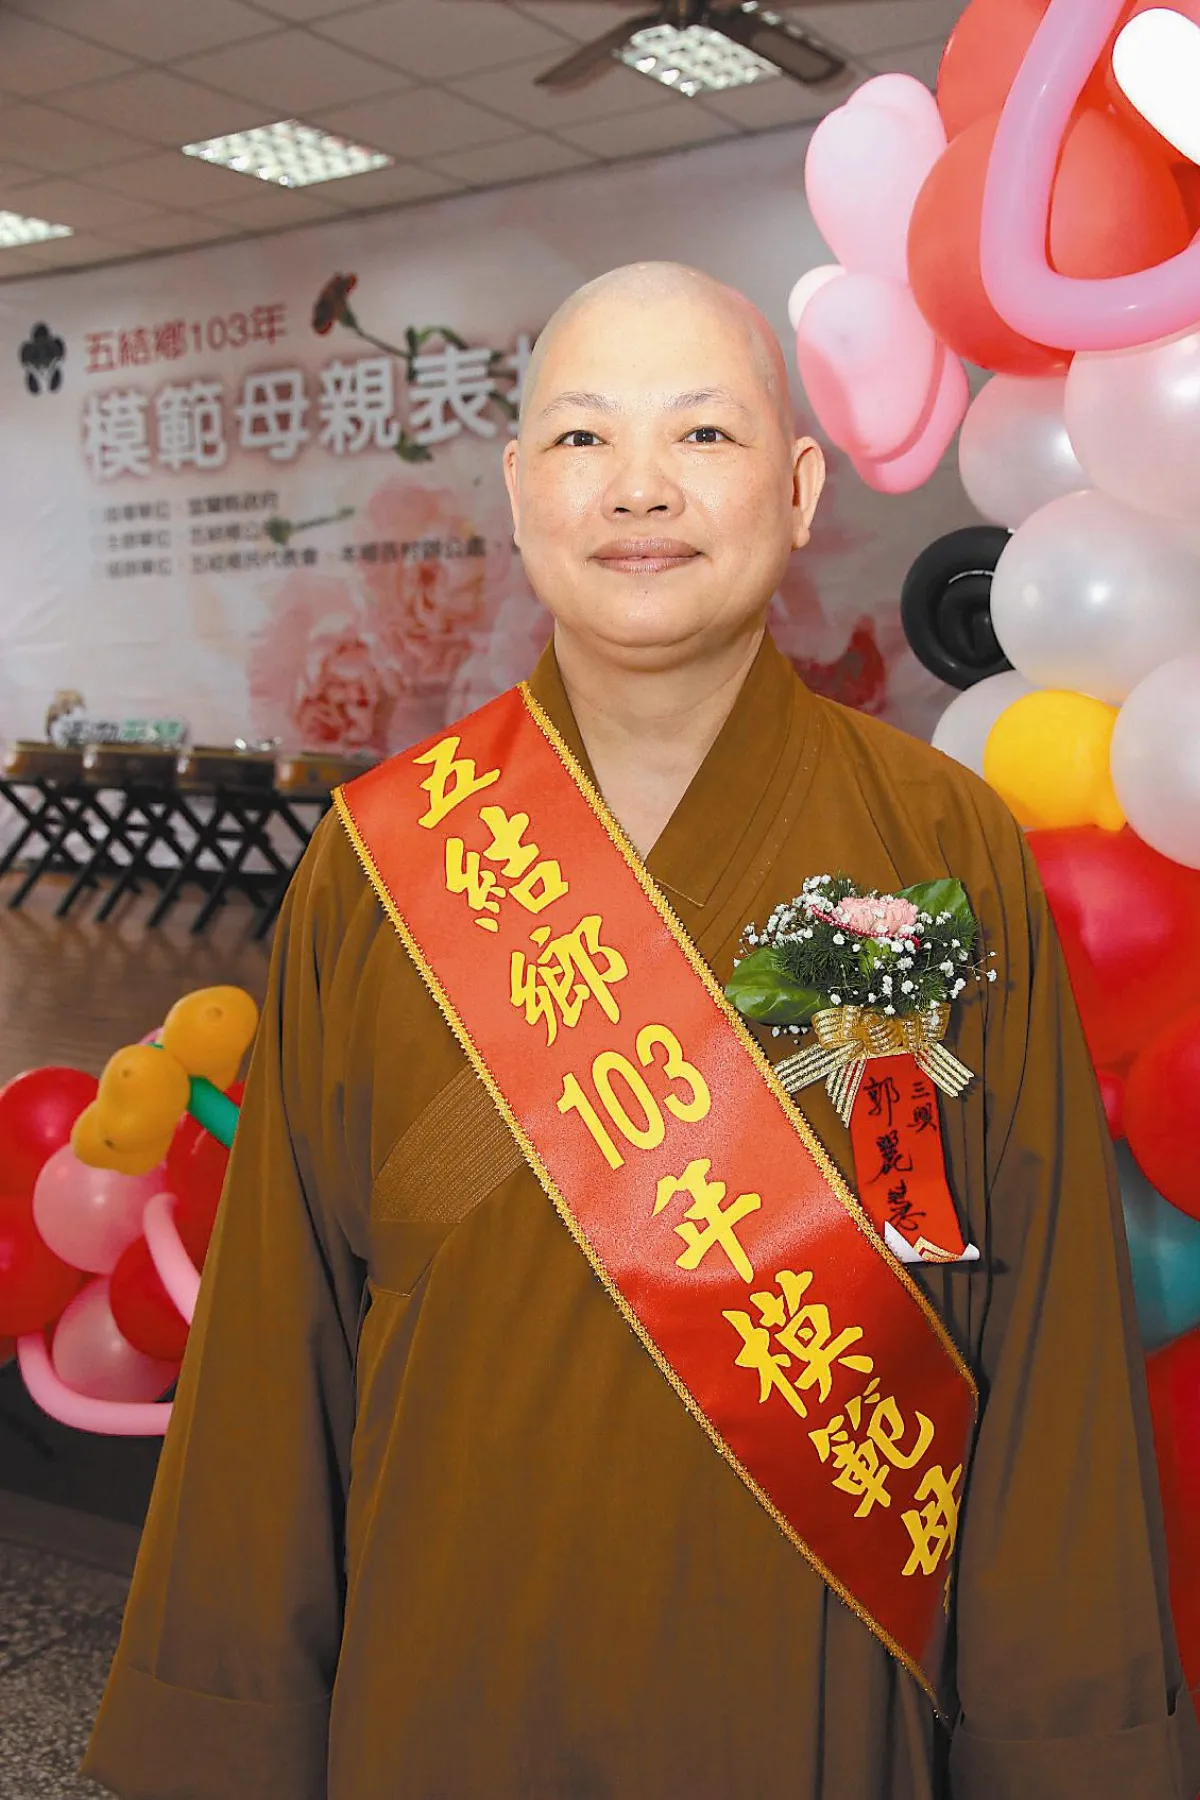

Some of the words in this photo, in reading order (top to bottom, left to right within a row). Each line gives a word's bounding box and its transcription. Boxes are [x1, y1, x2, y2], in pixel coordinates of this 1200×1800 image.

[84, 303, 287, 373] 五結鄉103年
[412, 736, 961, 1613] 五結鄉103年模範母
